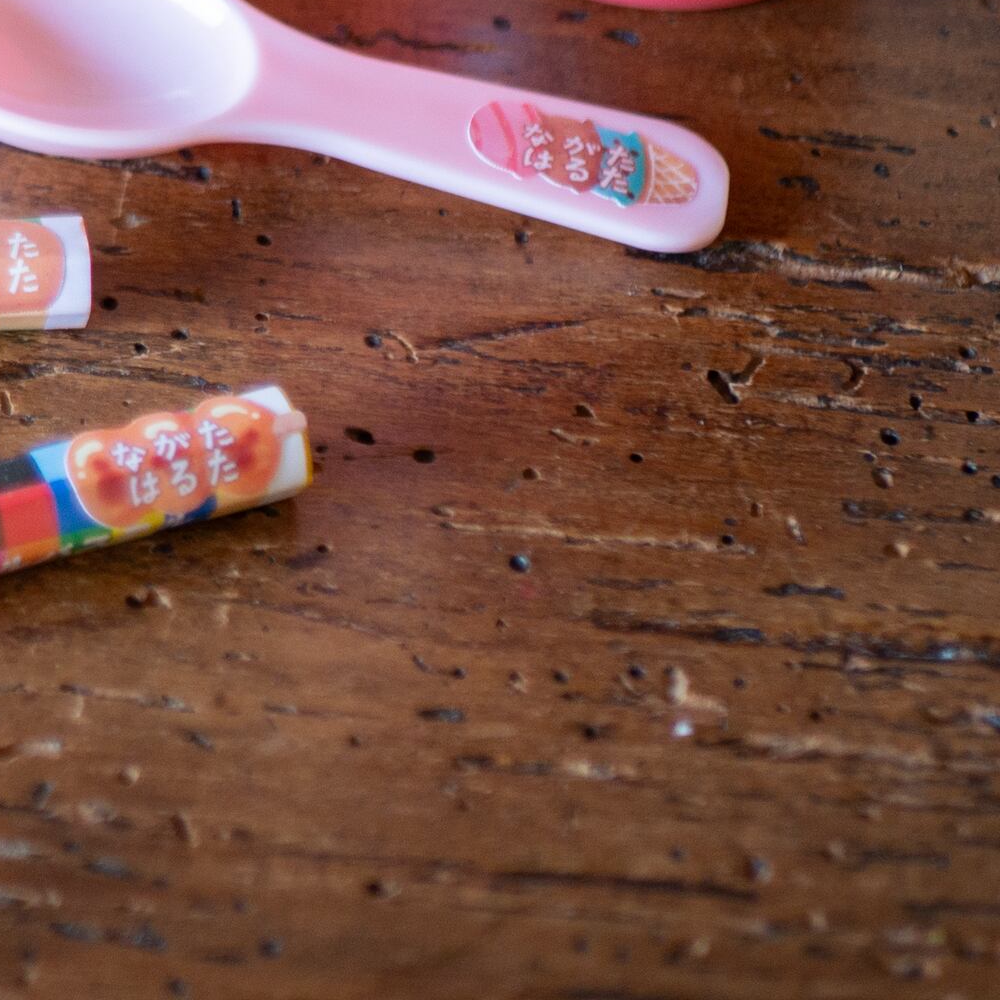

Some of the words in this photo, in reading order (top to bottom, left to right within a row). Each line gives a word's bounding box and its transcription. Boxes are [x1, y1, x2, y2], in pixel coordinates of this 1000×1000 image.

[523, 147, 629, 194] はるた
[524, 122, 636, 174] ながた
[111, 419, 235, 473] ながた
[129, 449, 239, 508] はるた
